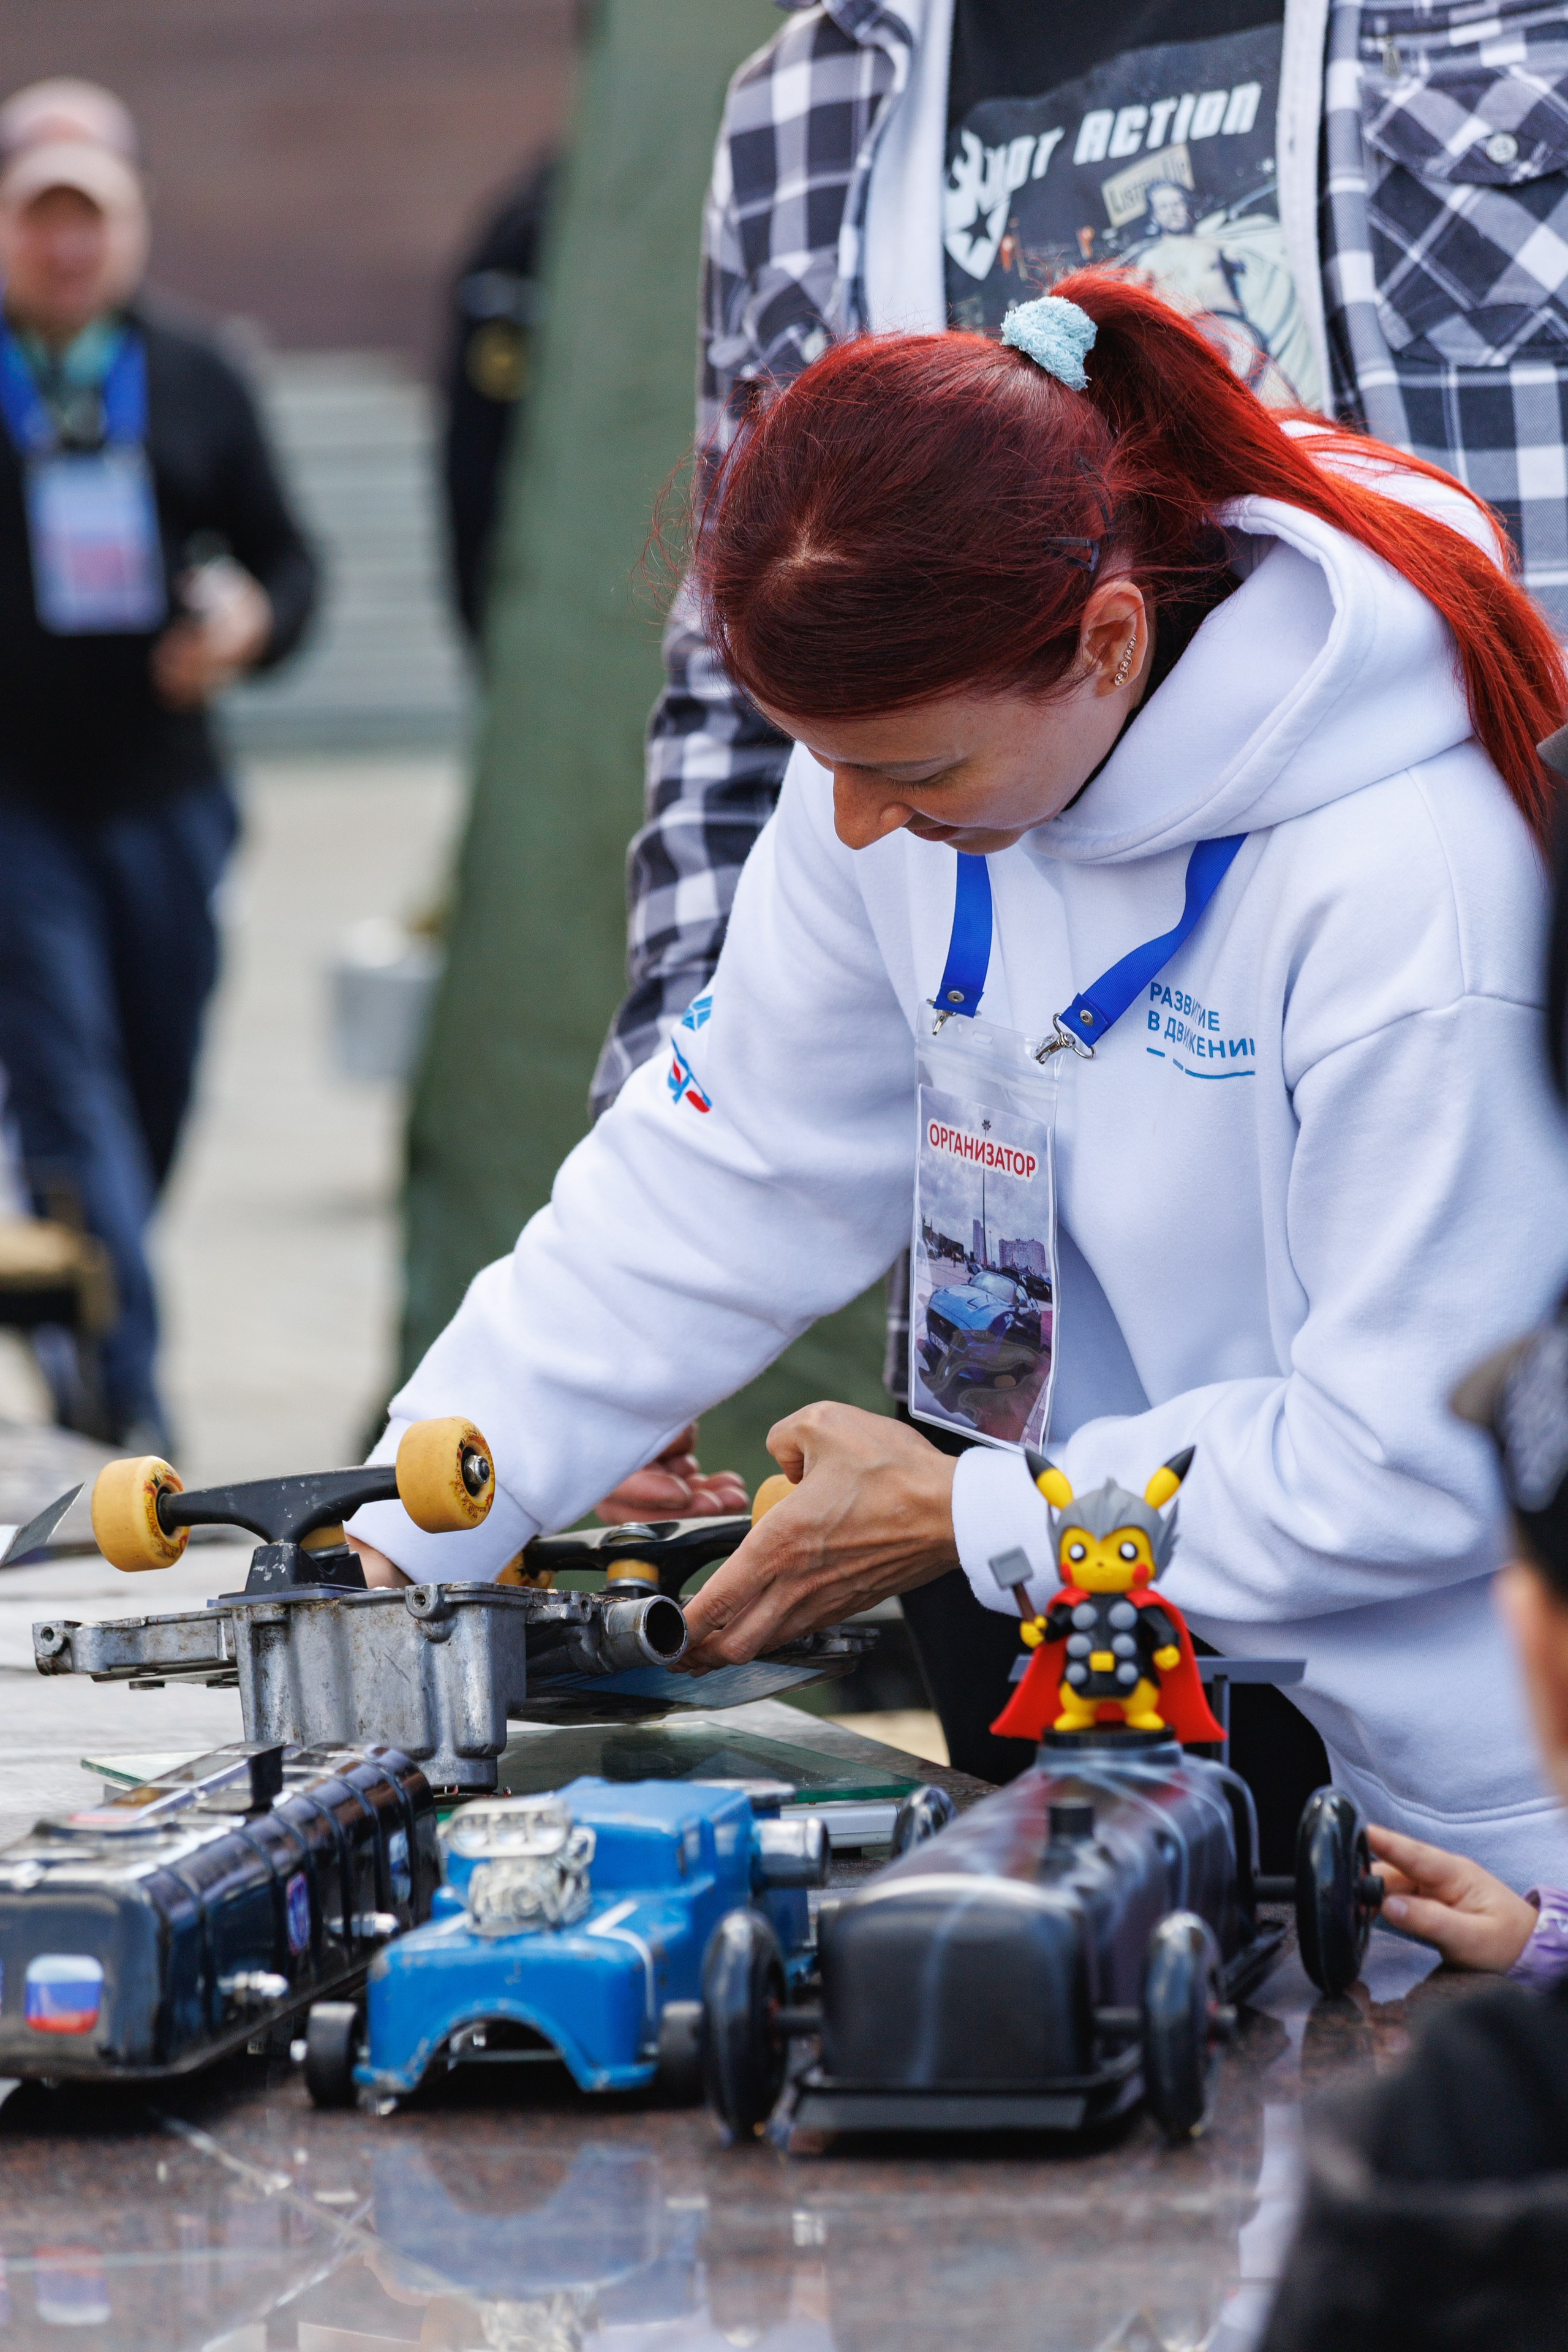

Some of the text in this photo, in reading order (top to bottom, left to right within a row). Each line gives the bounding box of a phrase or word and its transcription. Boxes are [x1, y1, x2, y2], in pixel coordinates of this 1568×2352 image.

[1072, 81, 1262, 165] ACTION
[1147, 1010, 1160, 1031] В
[1150, 981, 1220, 1031] РАЗВИТИЕ
[929, 1123, 1036, 1178] ОРГАНИЗАТОР
